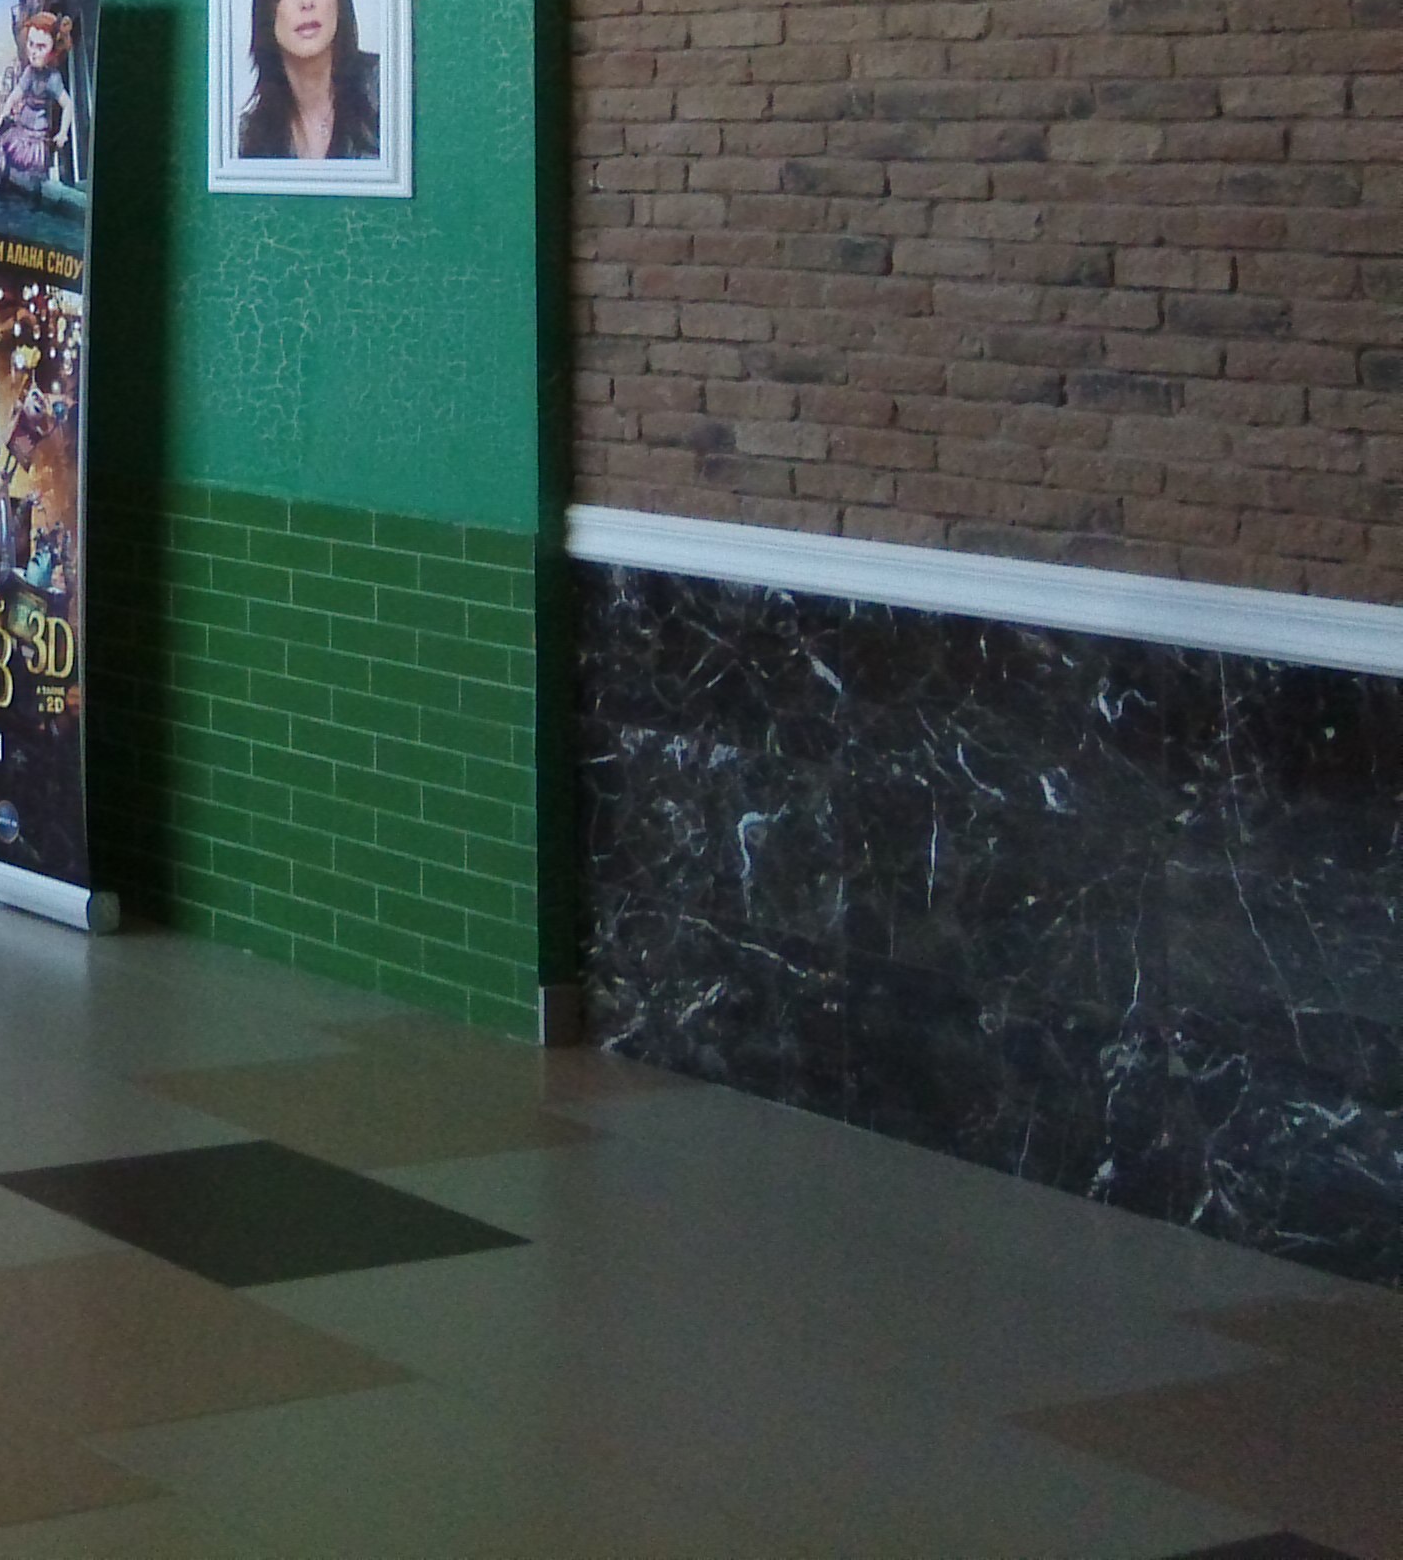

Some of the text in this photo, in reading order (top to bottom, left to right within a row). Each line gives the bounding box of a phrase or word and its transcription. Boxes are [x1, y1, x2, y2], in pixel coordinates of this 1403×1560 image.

[6, 241, 46, 270] АЛАНА
[47, 247, 83, 279] СНОУ
[25, 613, 74, 680] 3D
[46, 695, 65, 714] 2D
